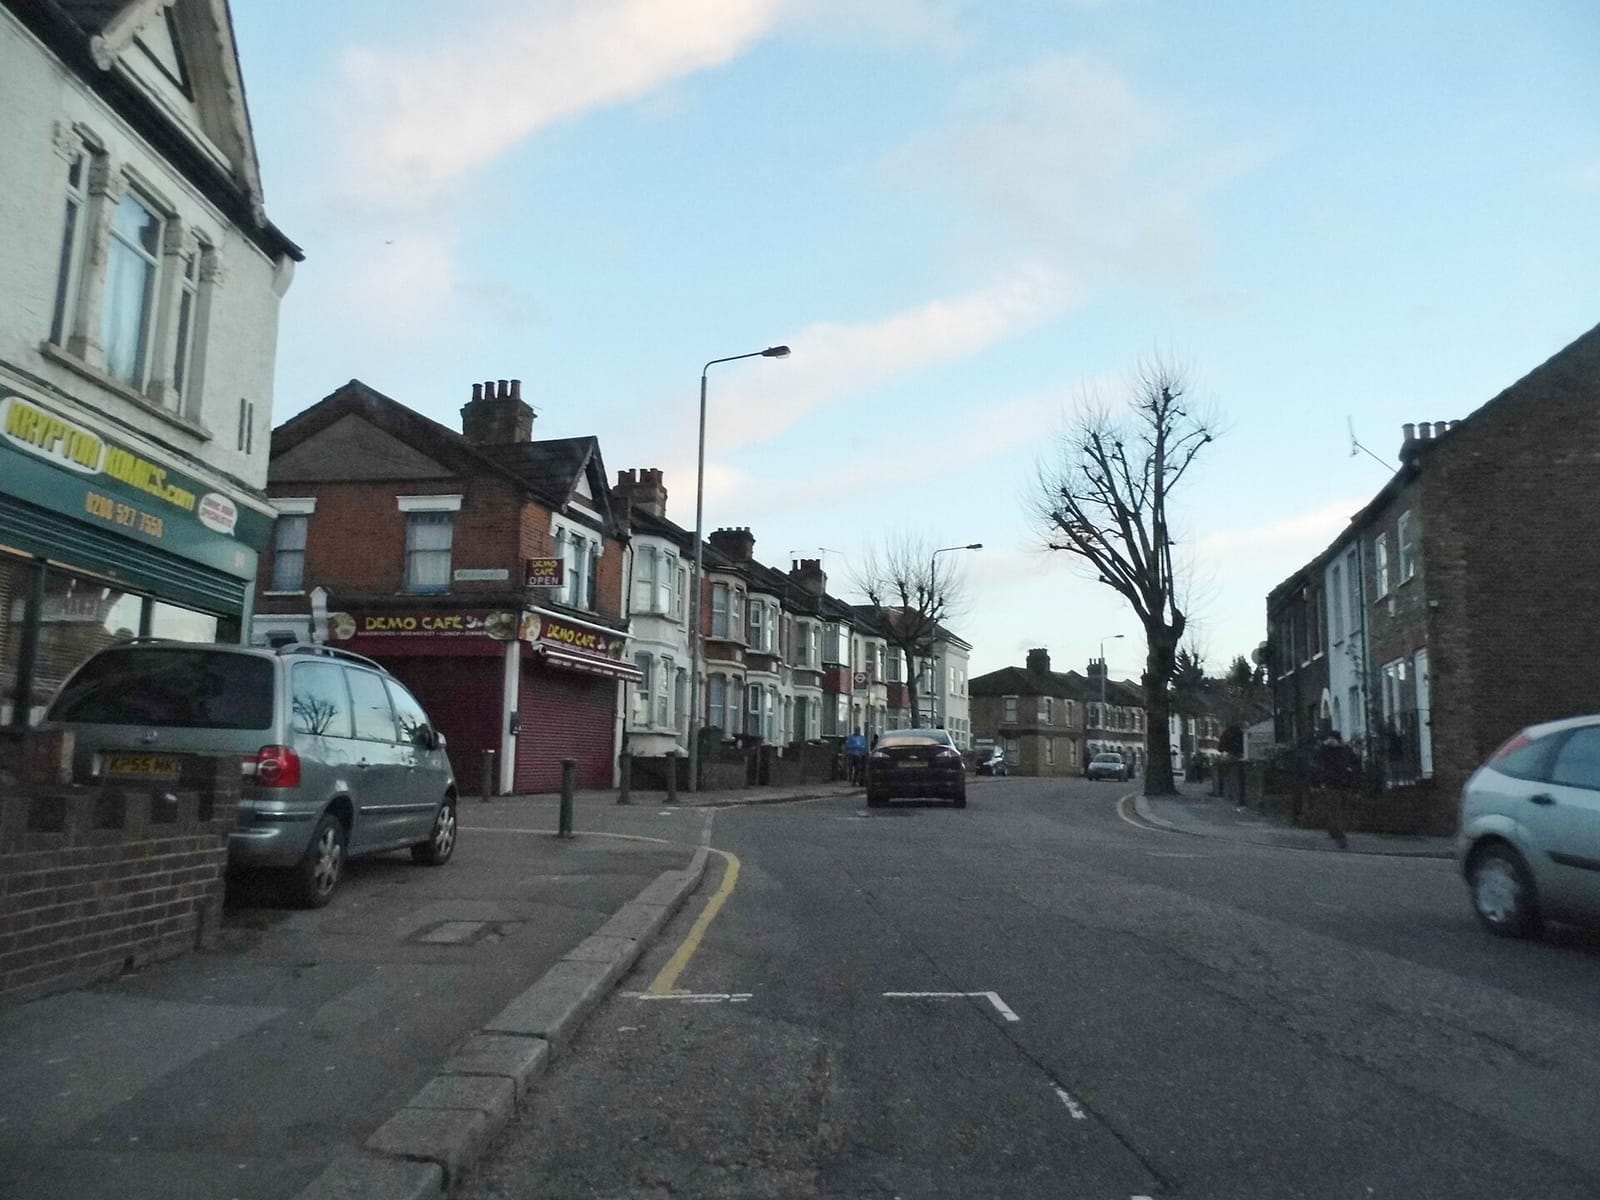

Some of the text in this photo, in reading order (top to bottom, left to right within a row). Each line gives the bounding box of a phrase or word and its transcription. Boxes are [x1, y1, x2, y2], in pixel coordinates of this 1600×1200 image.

[5, 401, 103, 471] KRYPTON
[532, 560, 558, 568] DEMO
[529, 576, 559, 585] OPEN
[365, 617, 417, 630] DEMO
[547, 623, 575, 643] DEMO
